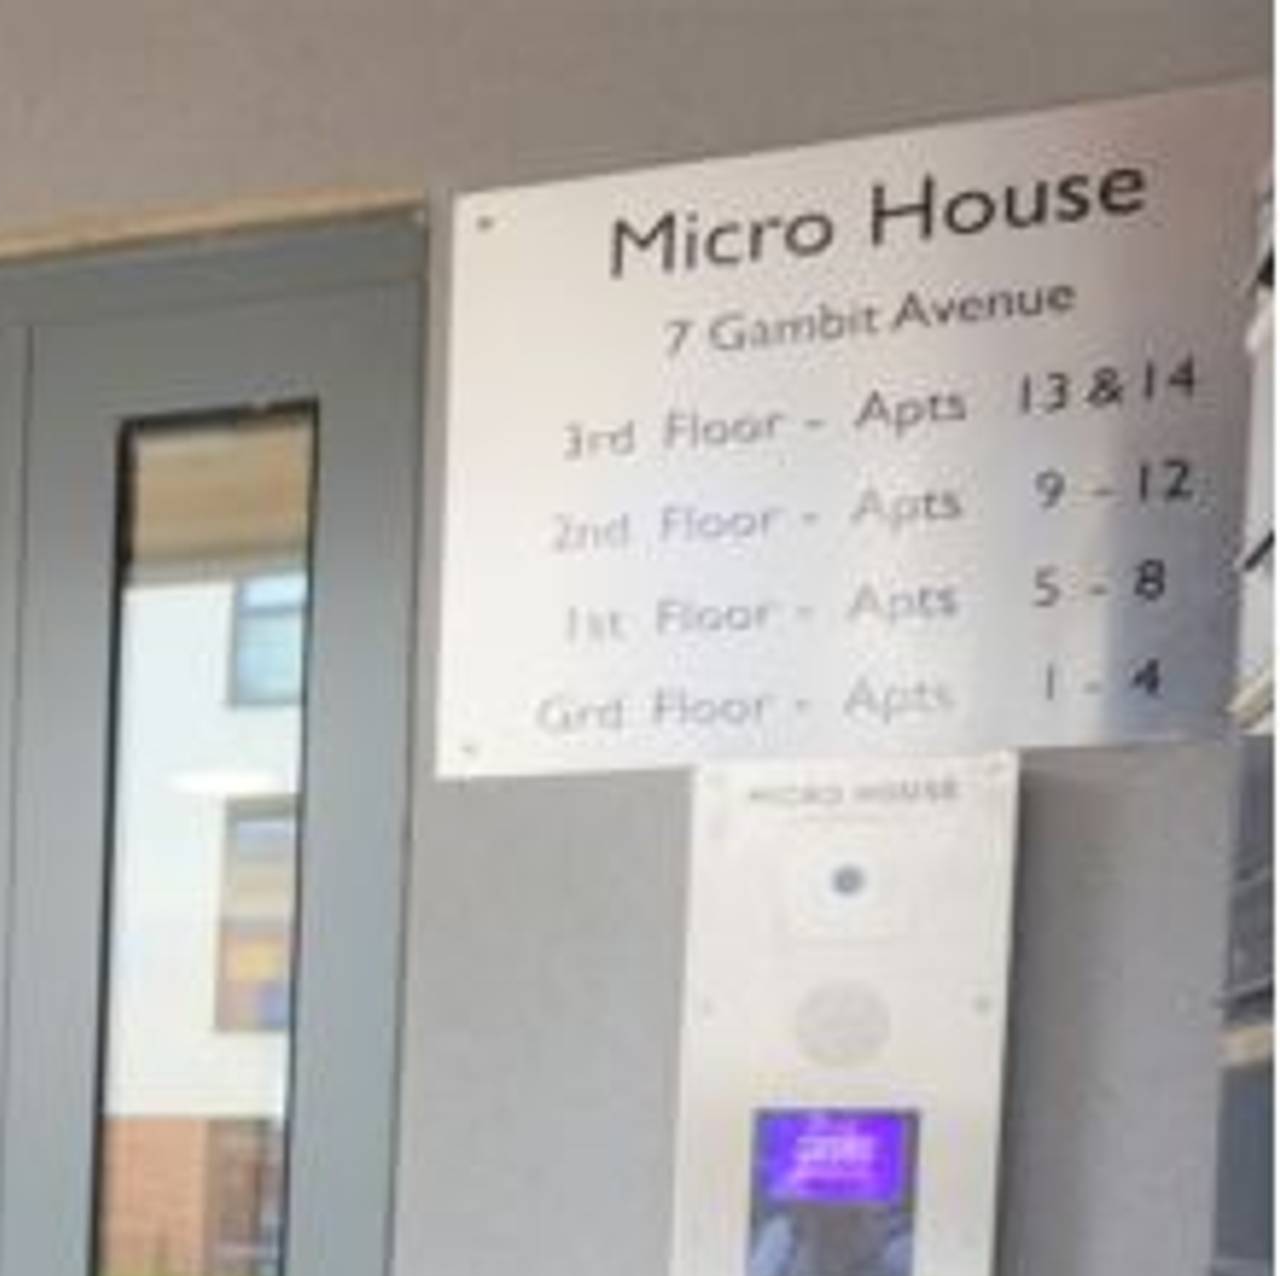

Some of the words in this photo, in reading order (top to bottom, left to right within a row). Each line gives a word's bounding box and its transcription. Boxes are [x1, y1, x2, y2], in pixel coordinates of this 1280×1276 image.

[610, 209, 834, 280] Micro
[870, 168, 1146, 246] House
[663, 318, 695, 354] 7
[708, 303, 880, 351] Gambit
[894, 284, 1078, 330] Avenue
[563, 419, 636, 461] 3rd
[663, 407, 787, 450] Floor
[854, 390, 967, 437] Apts
[1020, 371, 1071, 414] 13
[1086, 365, 1126, 409] &
[1143, 350, 1196, 400] 14
[552, 511, 631, 552] 2nd
[657, 504, 785, 544] Floor
[849, 486, 963, 533] Apts
[1036, 468, 1066, 507] 9
[1138, 456, 1193, 500] 12
[565, 603, 628, 643] 1st
[654, 596, 781, 637] Floor
[845, 581, 959, 627] Apts
[1034, 566, 1061, 608] 5
[1134, 556, 1166, 600] 8
[535, 693, 624, 735] Grd
[651, 684, 777, 724] Floor
[842, 675, 957, 724] Apts
[1044, 661, 1057, 701] 1
[1128, 656, 1163, 697] 4
